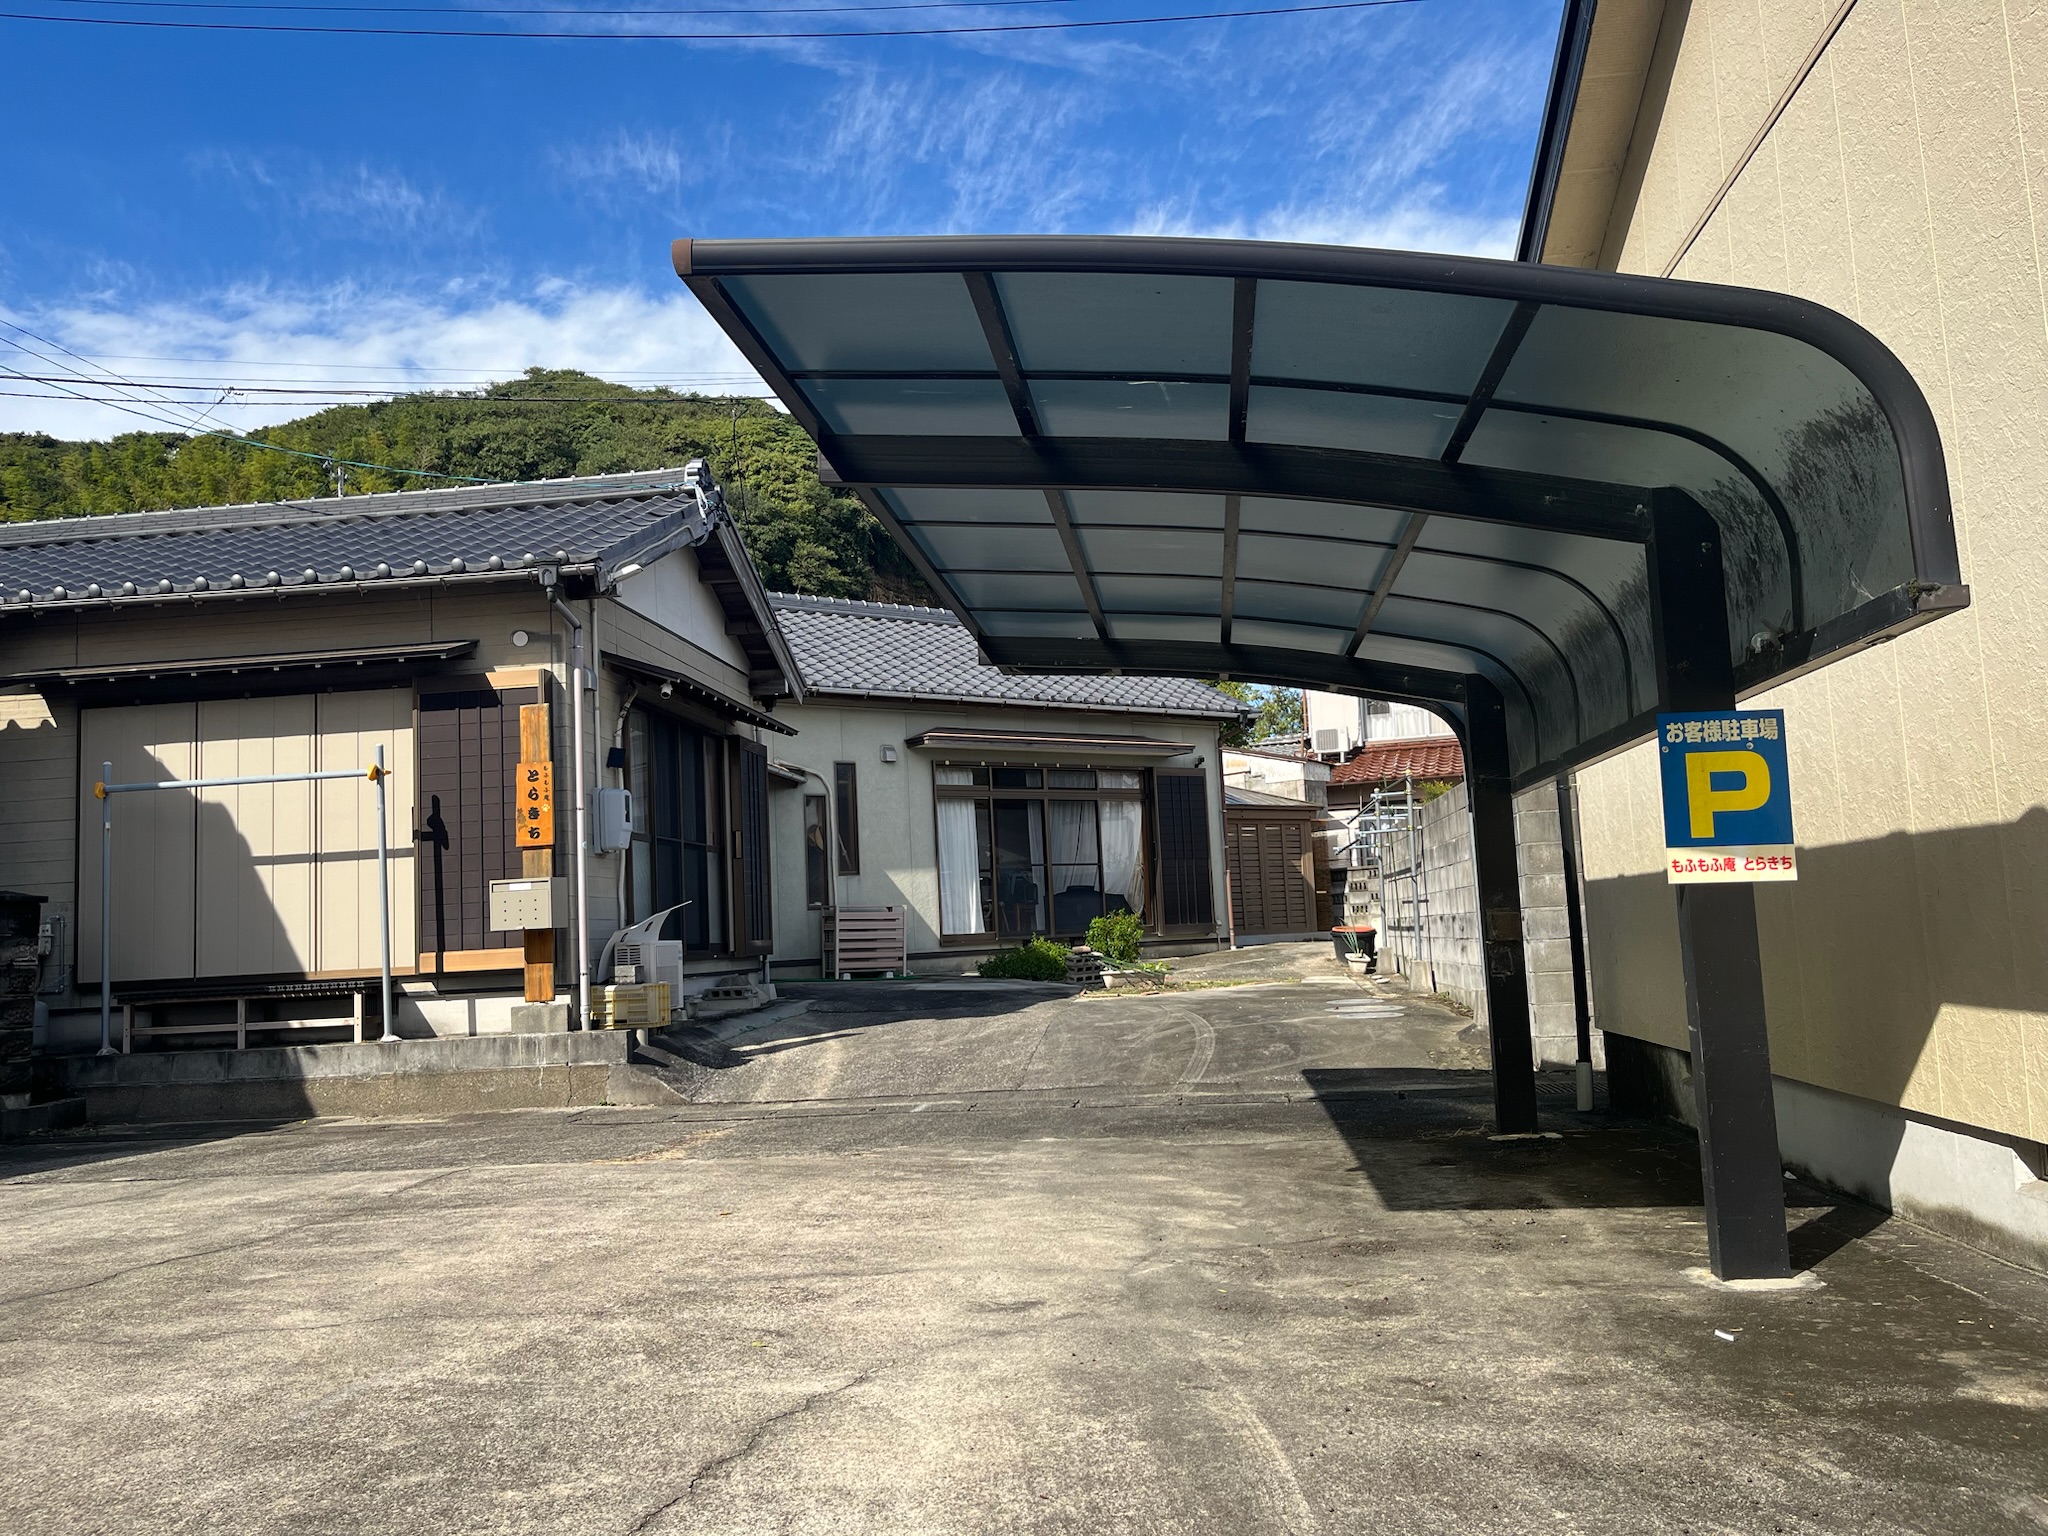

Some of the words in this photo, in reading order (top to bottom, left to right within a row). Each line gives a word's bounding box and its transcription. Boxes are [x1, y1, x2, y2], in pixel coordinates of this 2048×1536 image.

[1666, 718, 1778, 743] お客様駐車場
[527, 769, 541, 839] とらきち
[1685, 750, 1771, 839] P
[1671, 857, 1736, 873] もふもふ庵
[1743, 855, 1793, 871] とらきち
